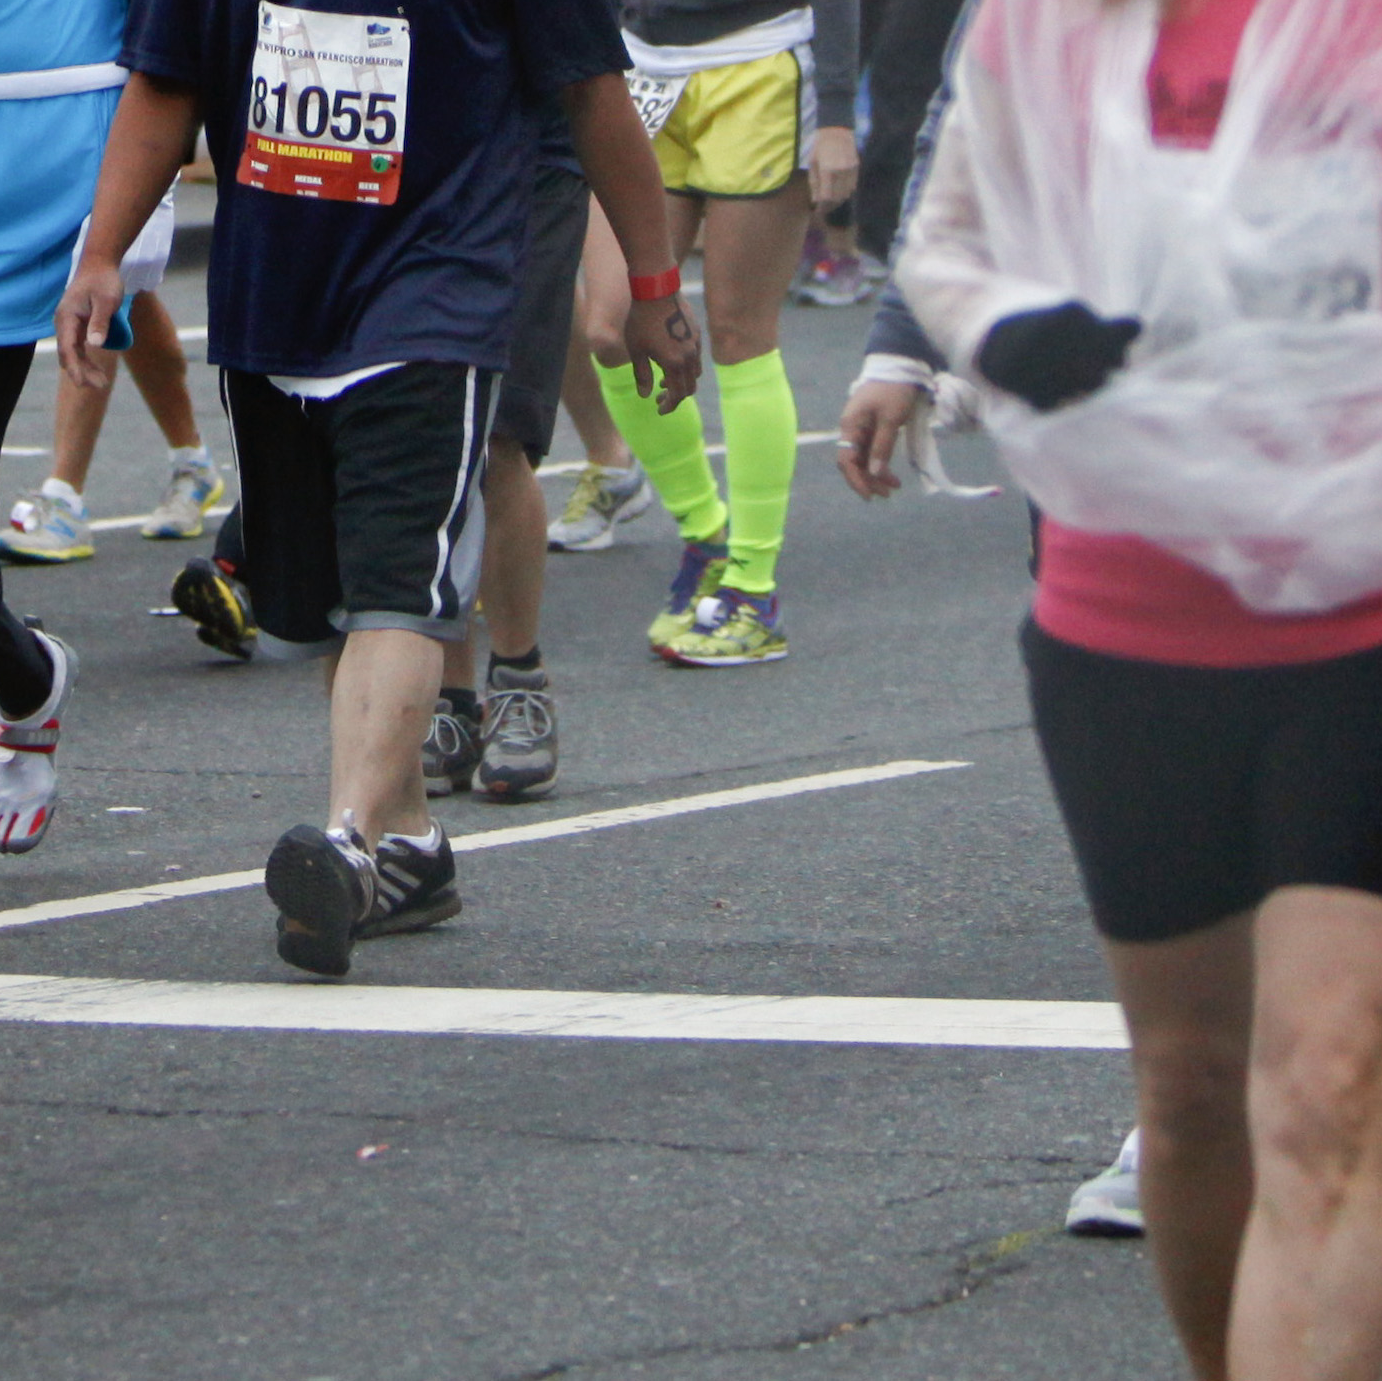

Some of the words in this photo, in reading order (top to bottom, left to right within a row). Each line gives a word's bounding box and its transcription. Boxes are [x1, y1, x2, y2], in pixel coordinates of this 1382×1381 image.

[264, 43, 296, 58] WIPRO
[297, 49, 315, 60] SAN
[317, 51, 364, 65] FRANCISCO
[365, 56, 404, 68] MARATHON
[253, 75, 397, 146] 81055
[257, 138, 275, 154] FULL
[278, 144, 353, 164] MARATHON
[294, 174, 323, 185] MEDAL
